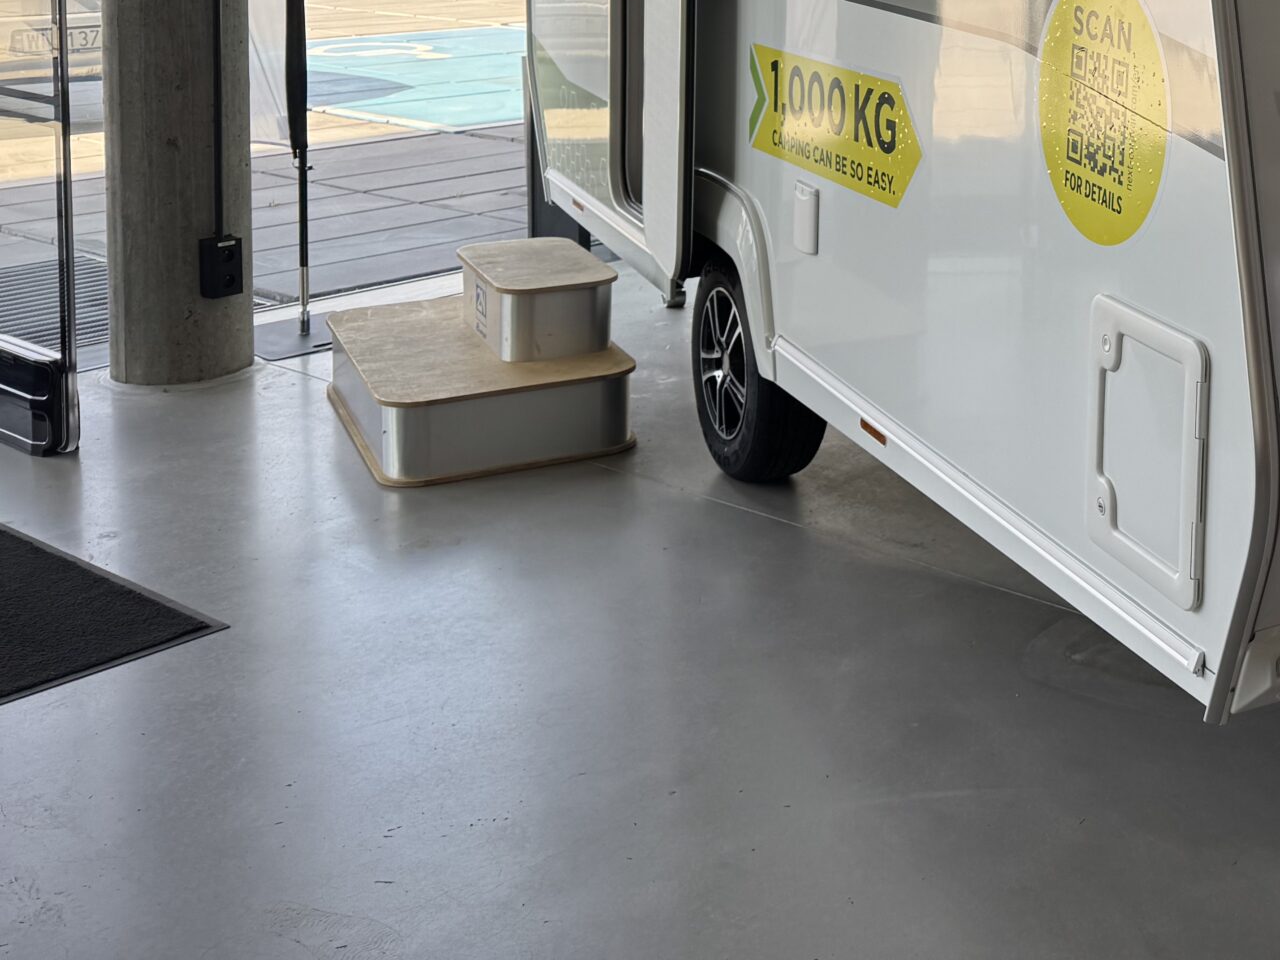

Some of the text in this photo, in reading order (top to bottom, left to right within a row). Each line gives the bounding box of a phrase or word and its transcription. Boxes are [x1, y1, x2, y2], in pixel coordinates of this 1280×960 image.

[1072, 5, 1132, 53] SCAN
[770, 59, 897, 155] 1,000 KG
[772, 129, 896, 195] CAMPING CAN BE SO EASY.
[1064, 170, 1123, 215] FOR DETAILS
